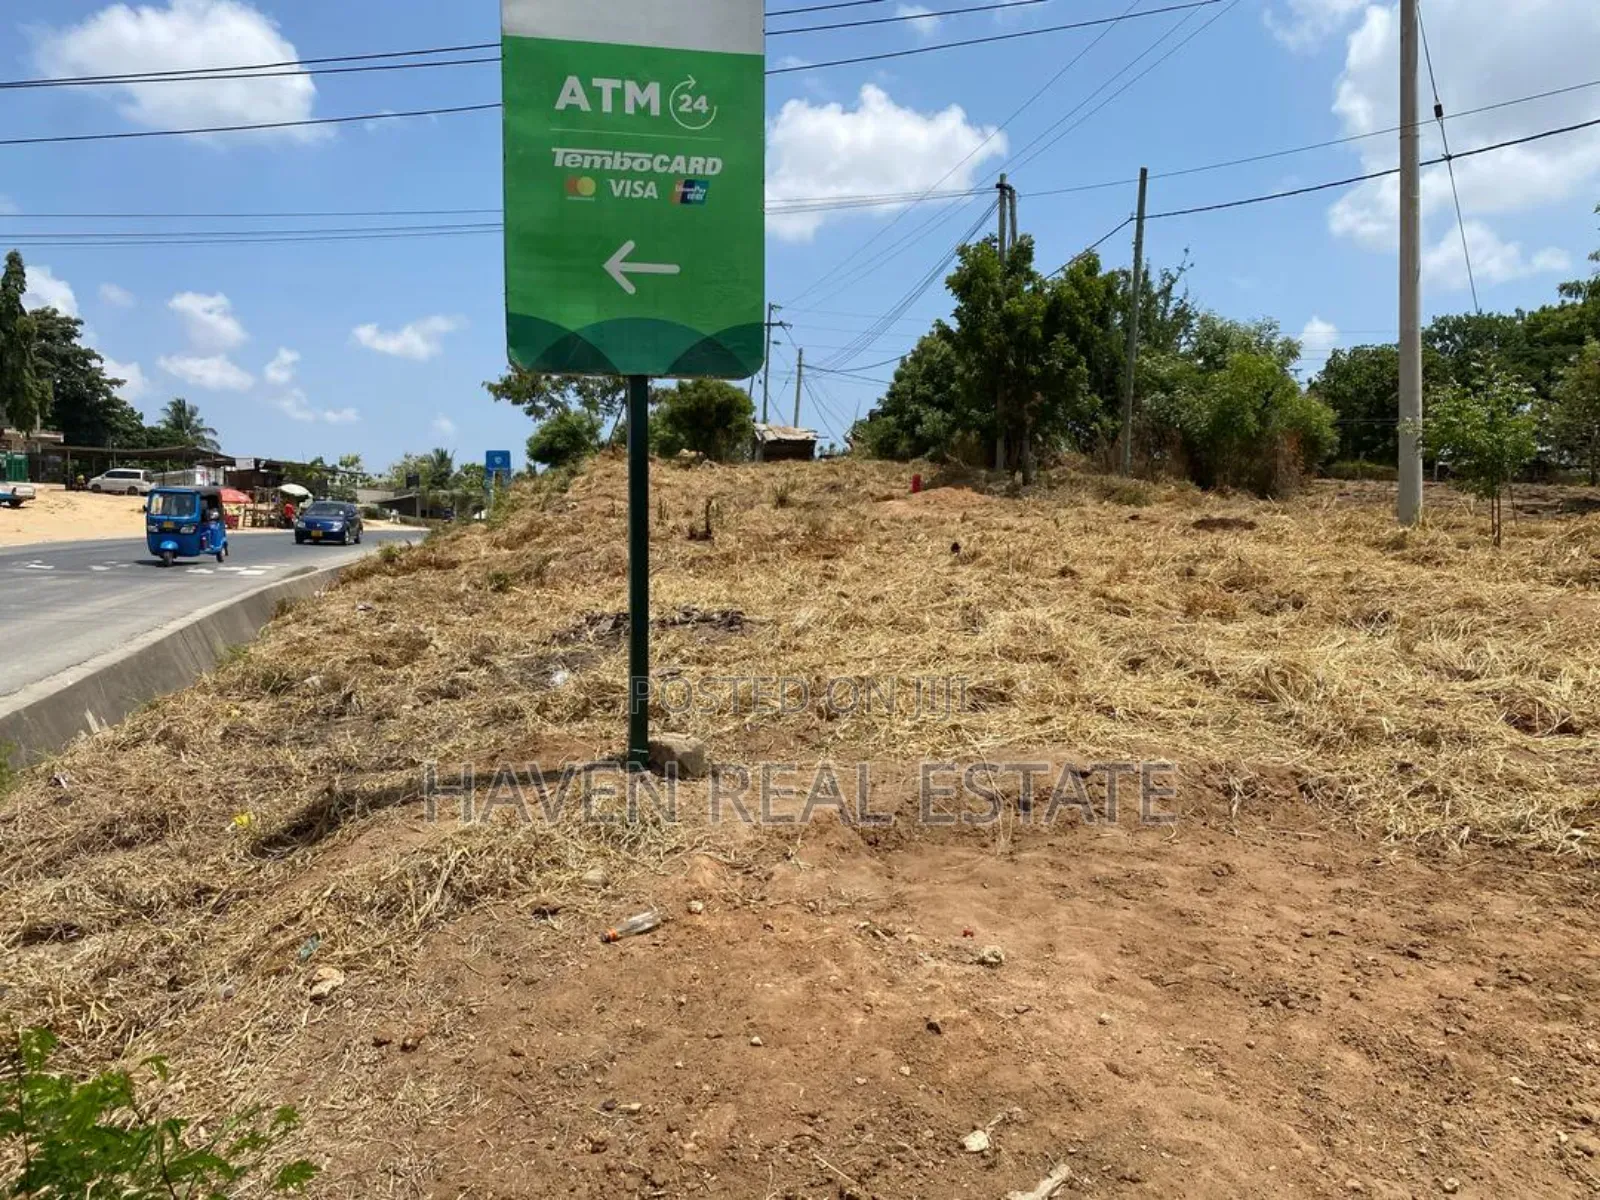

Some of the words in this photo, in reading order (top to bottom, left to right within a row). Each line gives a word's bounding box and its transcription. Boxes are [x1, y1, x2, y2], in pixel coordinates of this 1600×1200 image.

[554, 74, 661, 117] ATM
[678, 94, 709, 113] 24
[608, 178, 659, 199] VISA
